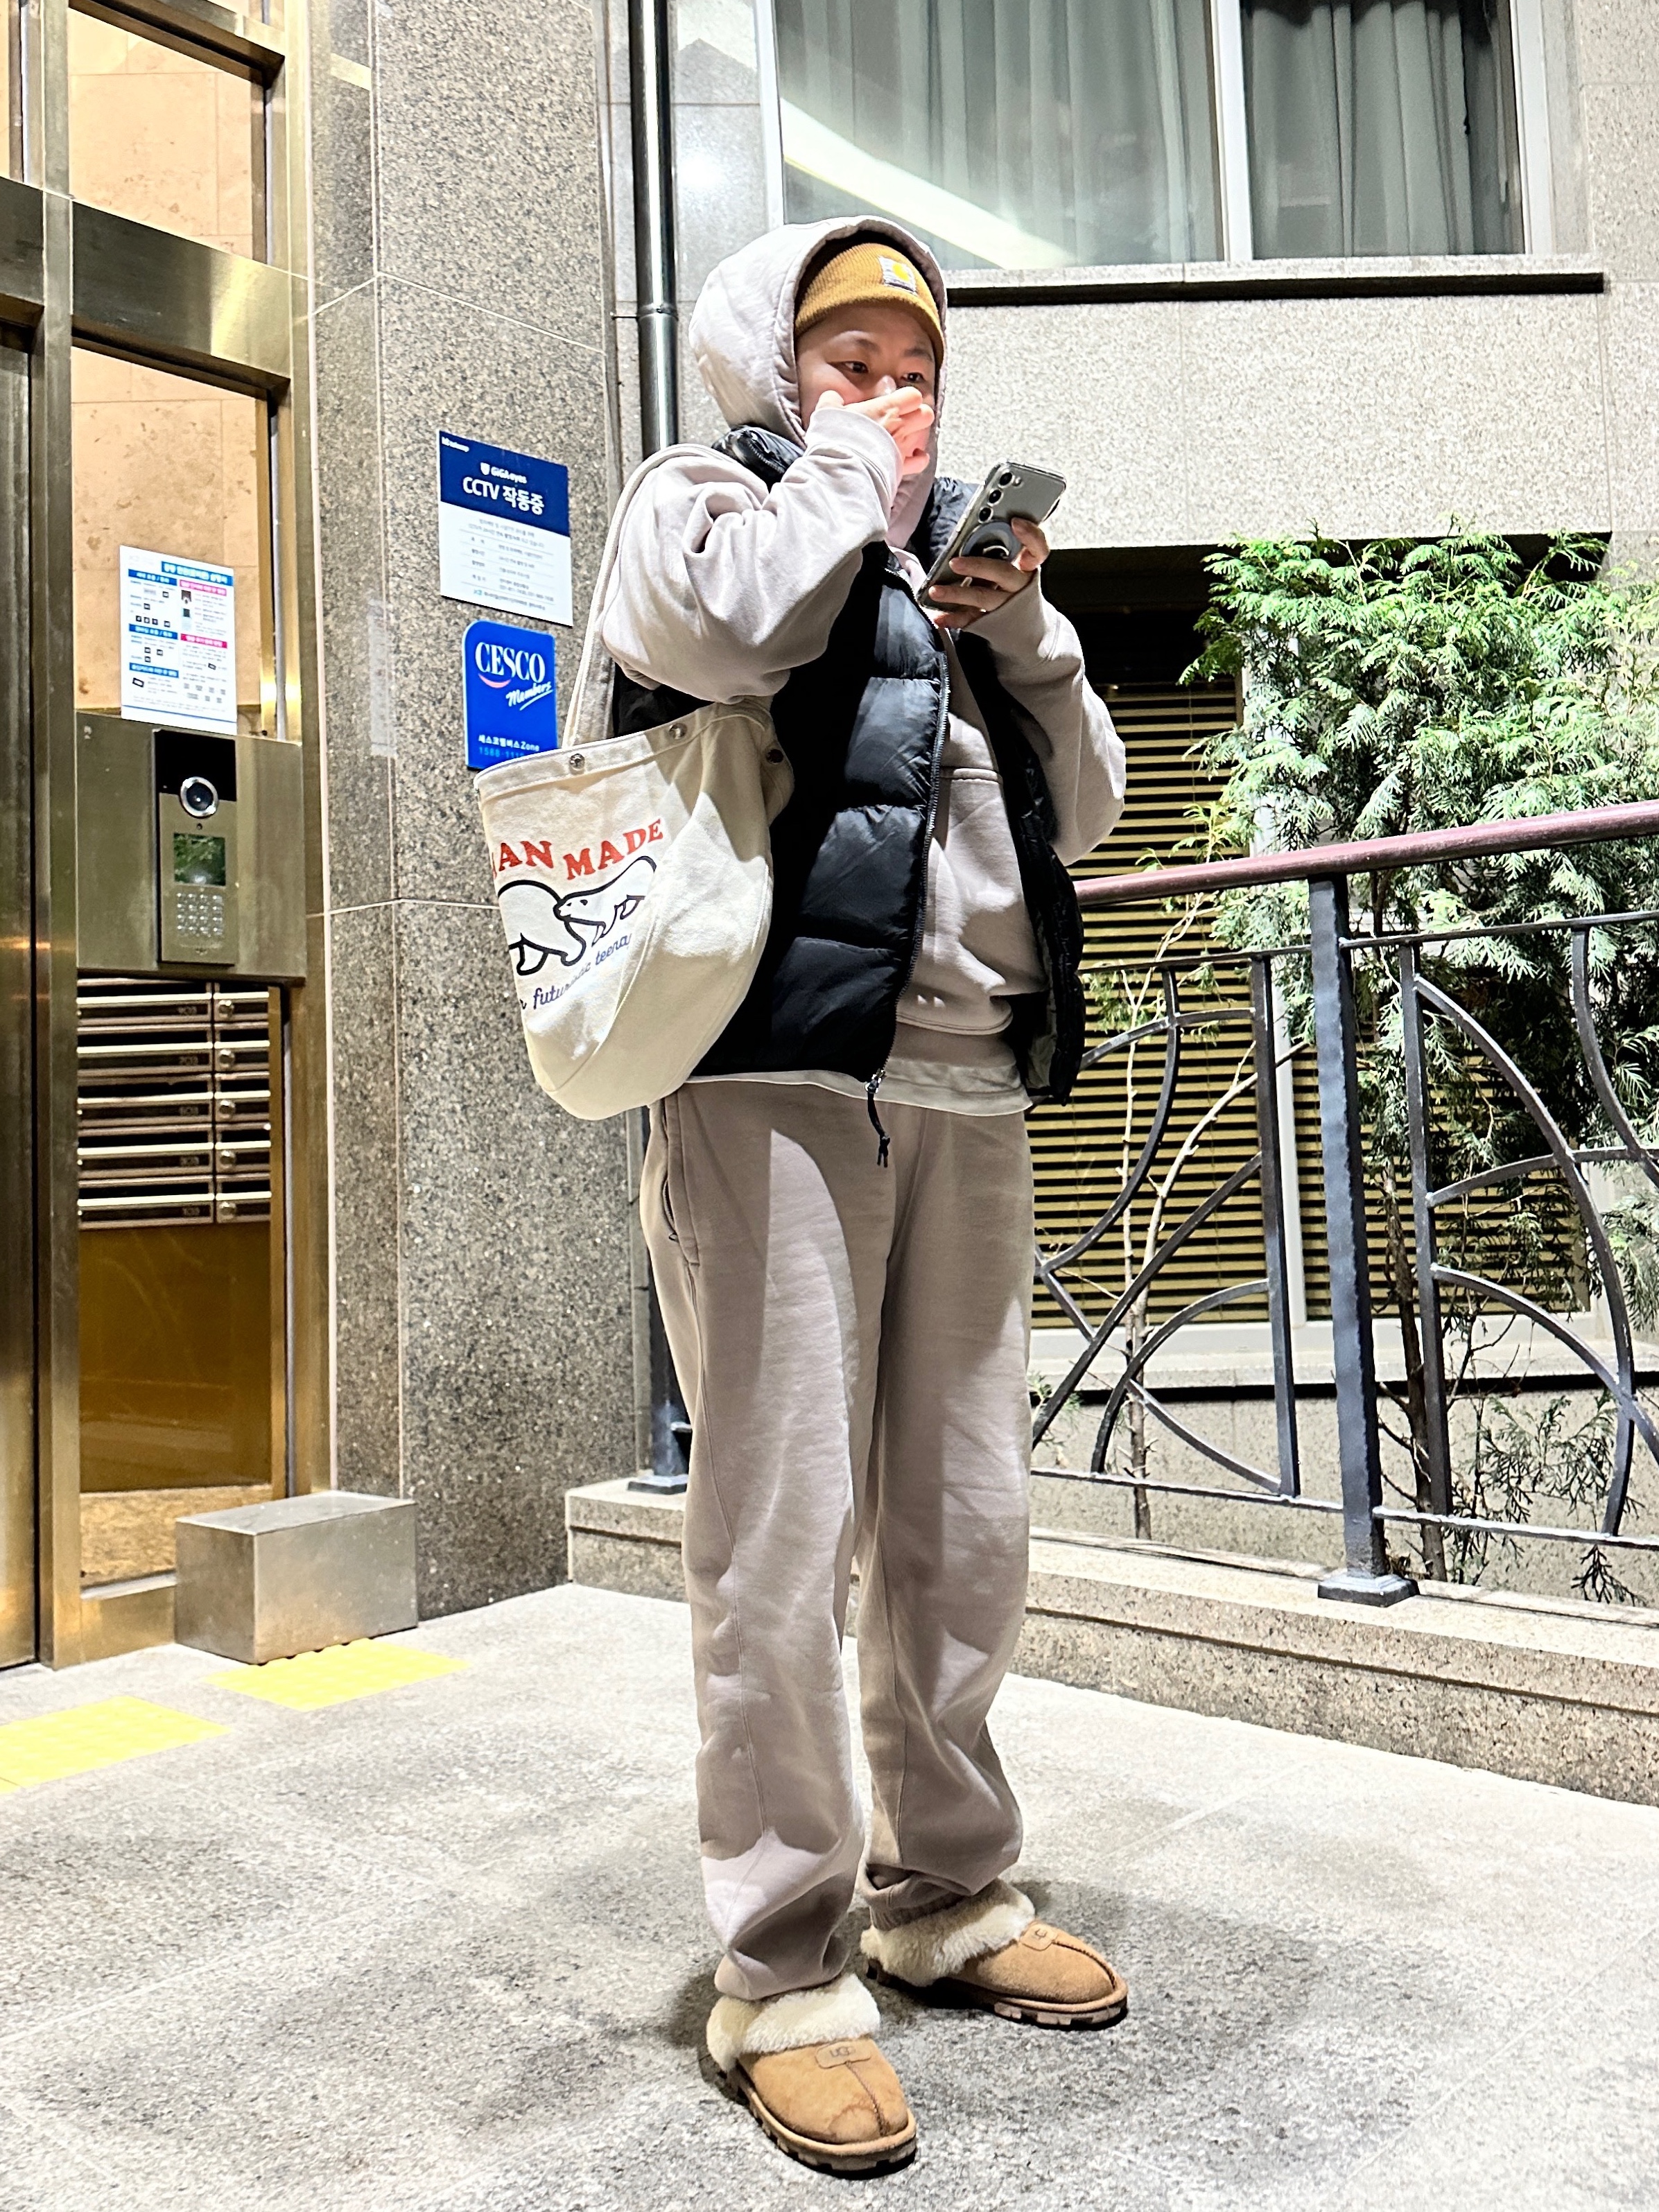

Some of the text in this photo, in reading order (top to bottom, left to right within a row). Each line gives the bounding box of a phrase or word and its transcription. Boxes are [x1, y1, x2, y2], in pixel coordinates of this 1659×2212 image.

[462, 476, 545, 515] CCTV 작동중
[475, 642, 546, 683] CESCO
[505, 681, 553, 707] Members
[492, 818, 664, 881] AN MADE
